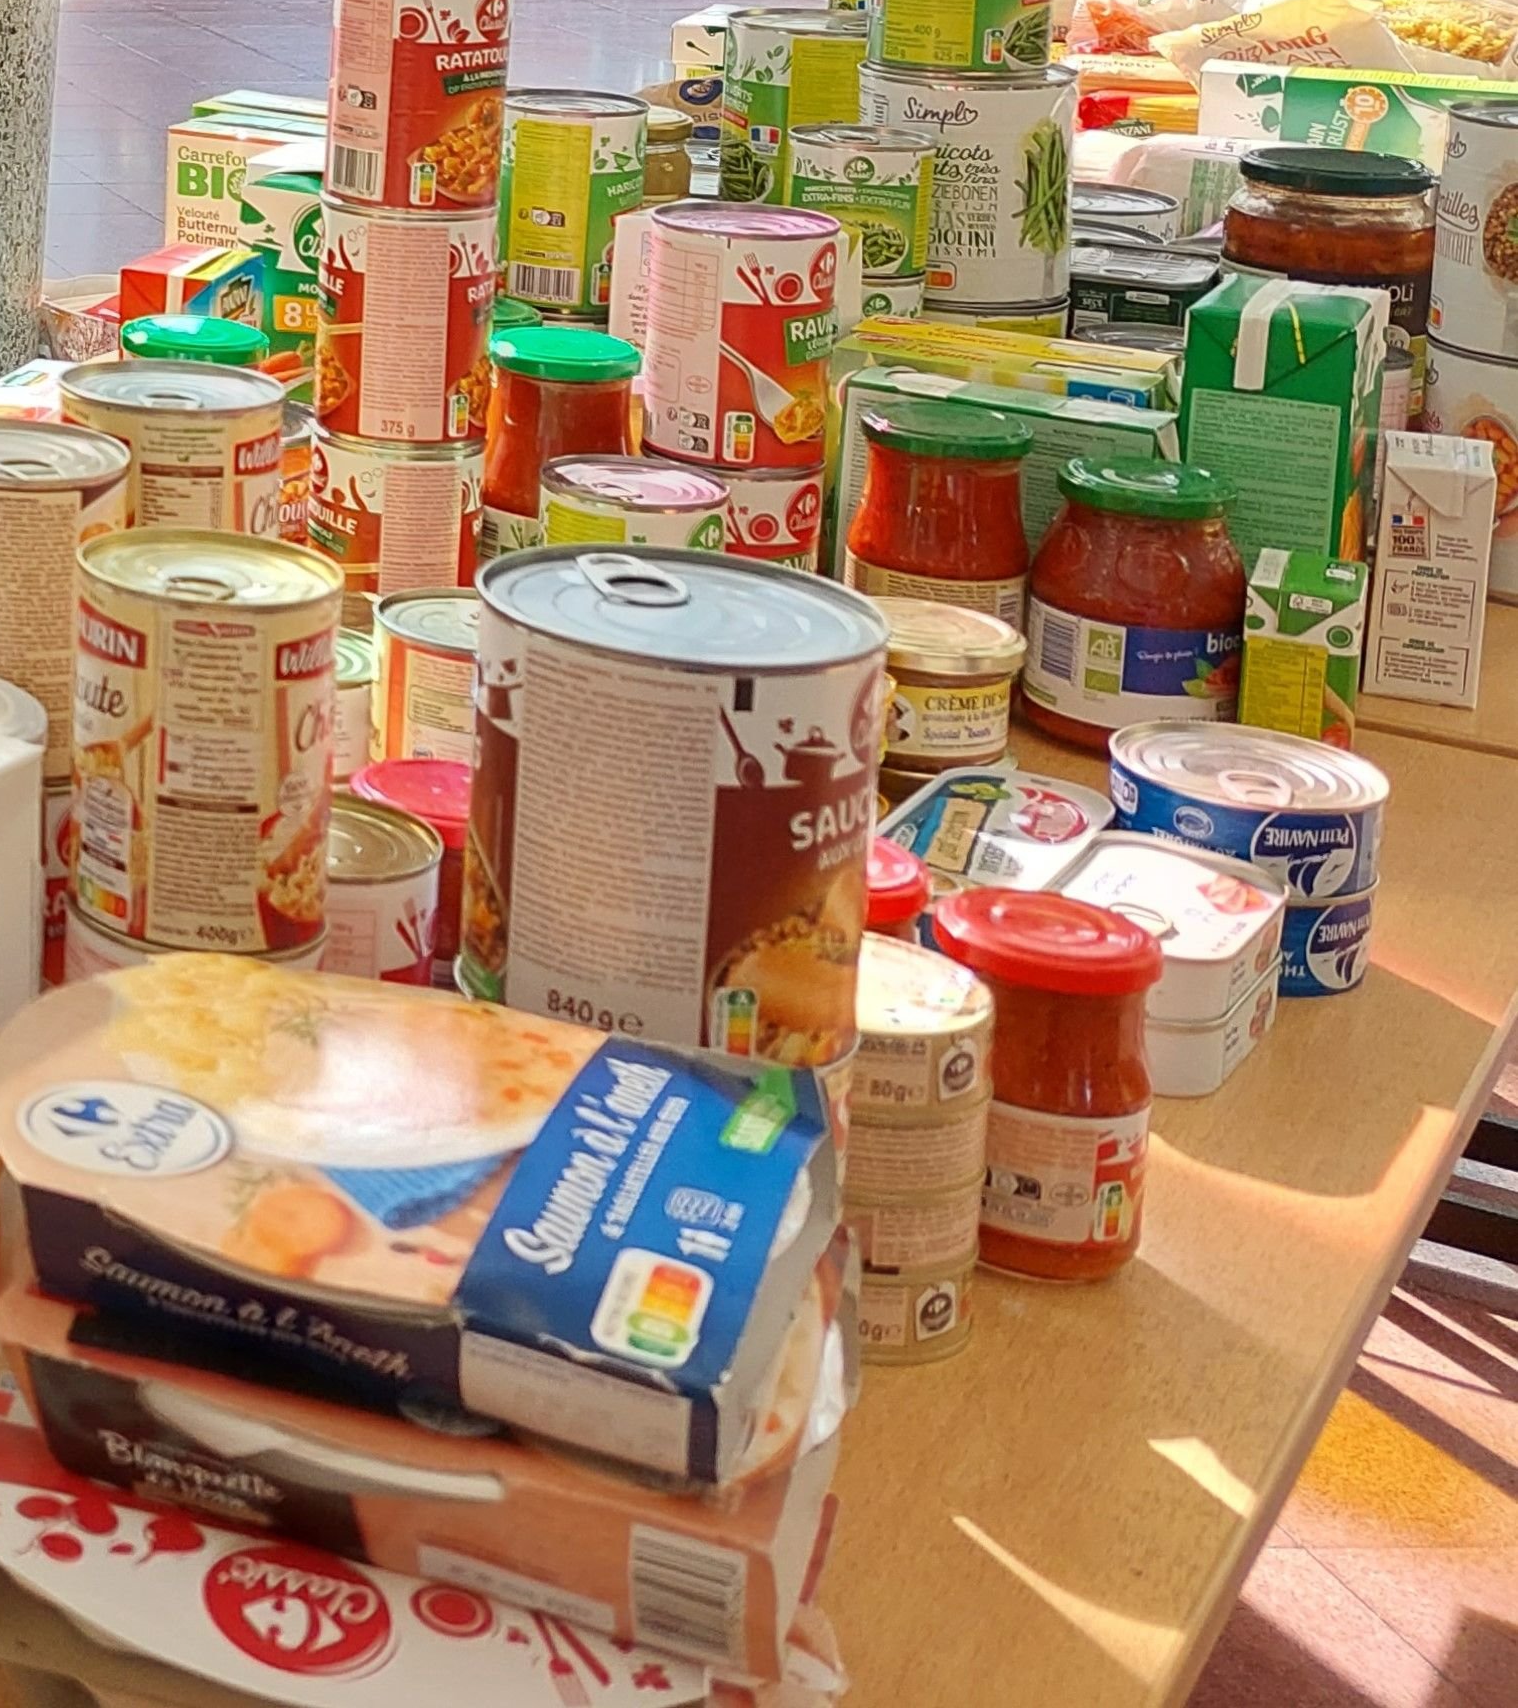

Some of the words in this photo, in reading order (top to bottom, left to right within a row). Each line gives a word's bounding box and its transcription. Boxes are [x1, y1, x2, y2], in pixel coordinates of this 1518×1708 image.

[914, 24, 932, 36] 400
[177, 206, 220, 221] Velouté
[177, 218, 237, 235] Butternu
[283, 302, 302, 327] 8
[381, 420, 403, 433] 375
[924, 692, 979, 711] CRÈME
[1265, 827, 1317, 849] NAVIRE
[1318, 922, 1358, 942] NAVIRE
[547, 989, 594, 1024] 840
[503, 1151, 618, 1275] Saumon
[80, 1246, 231, 1314] Saumon
